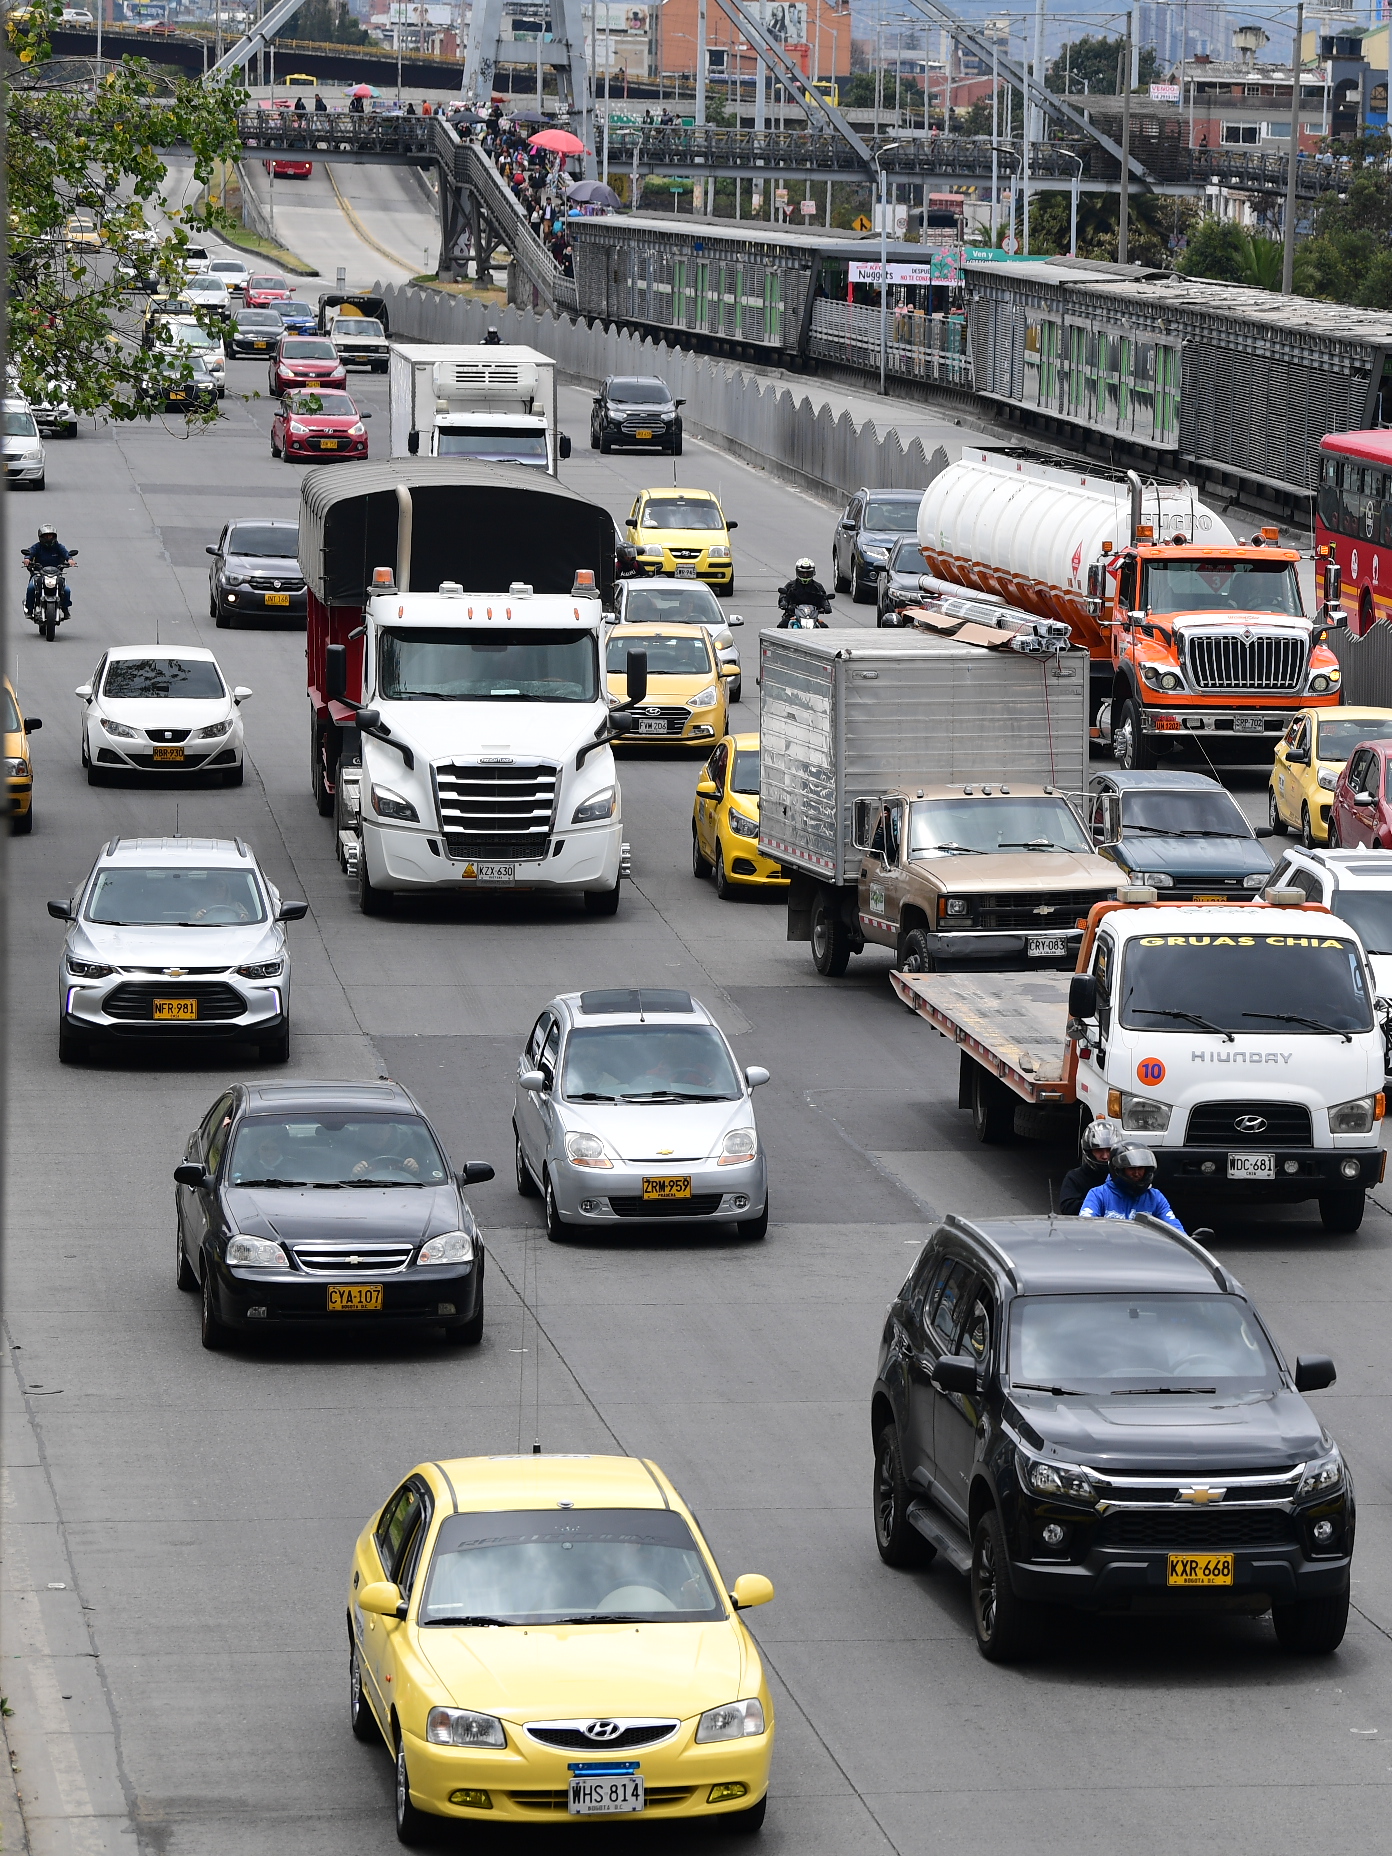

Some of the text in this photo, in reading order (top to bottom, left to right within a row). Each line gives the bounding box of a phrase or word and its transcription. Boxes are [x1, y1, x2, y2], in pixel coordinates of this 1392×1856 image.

[858, 269, 894, 281] Nuggts
[1212, 576, 1221, 588] 3
[1139, 935, 1345, 950] GRUAS CHIA
[1191, 1050, 1292, 1063] HIUNDAY
[1142, 1063, 1162, 1079] 10
